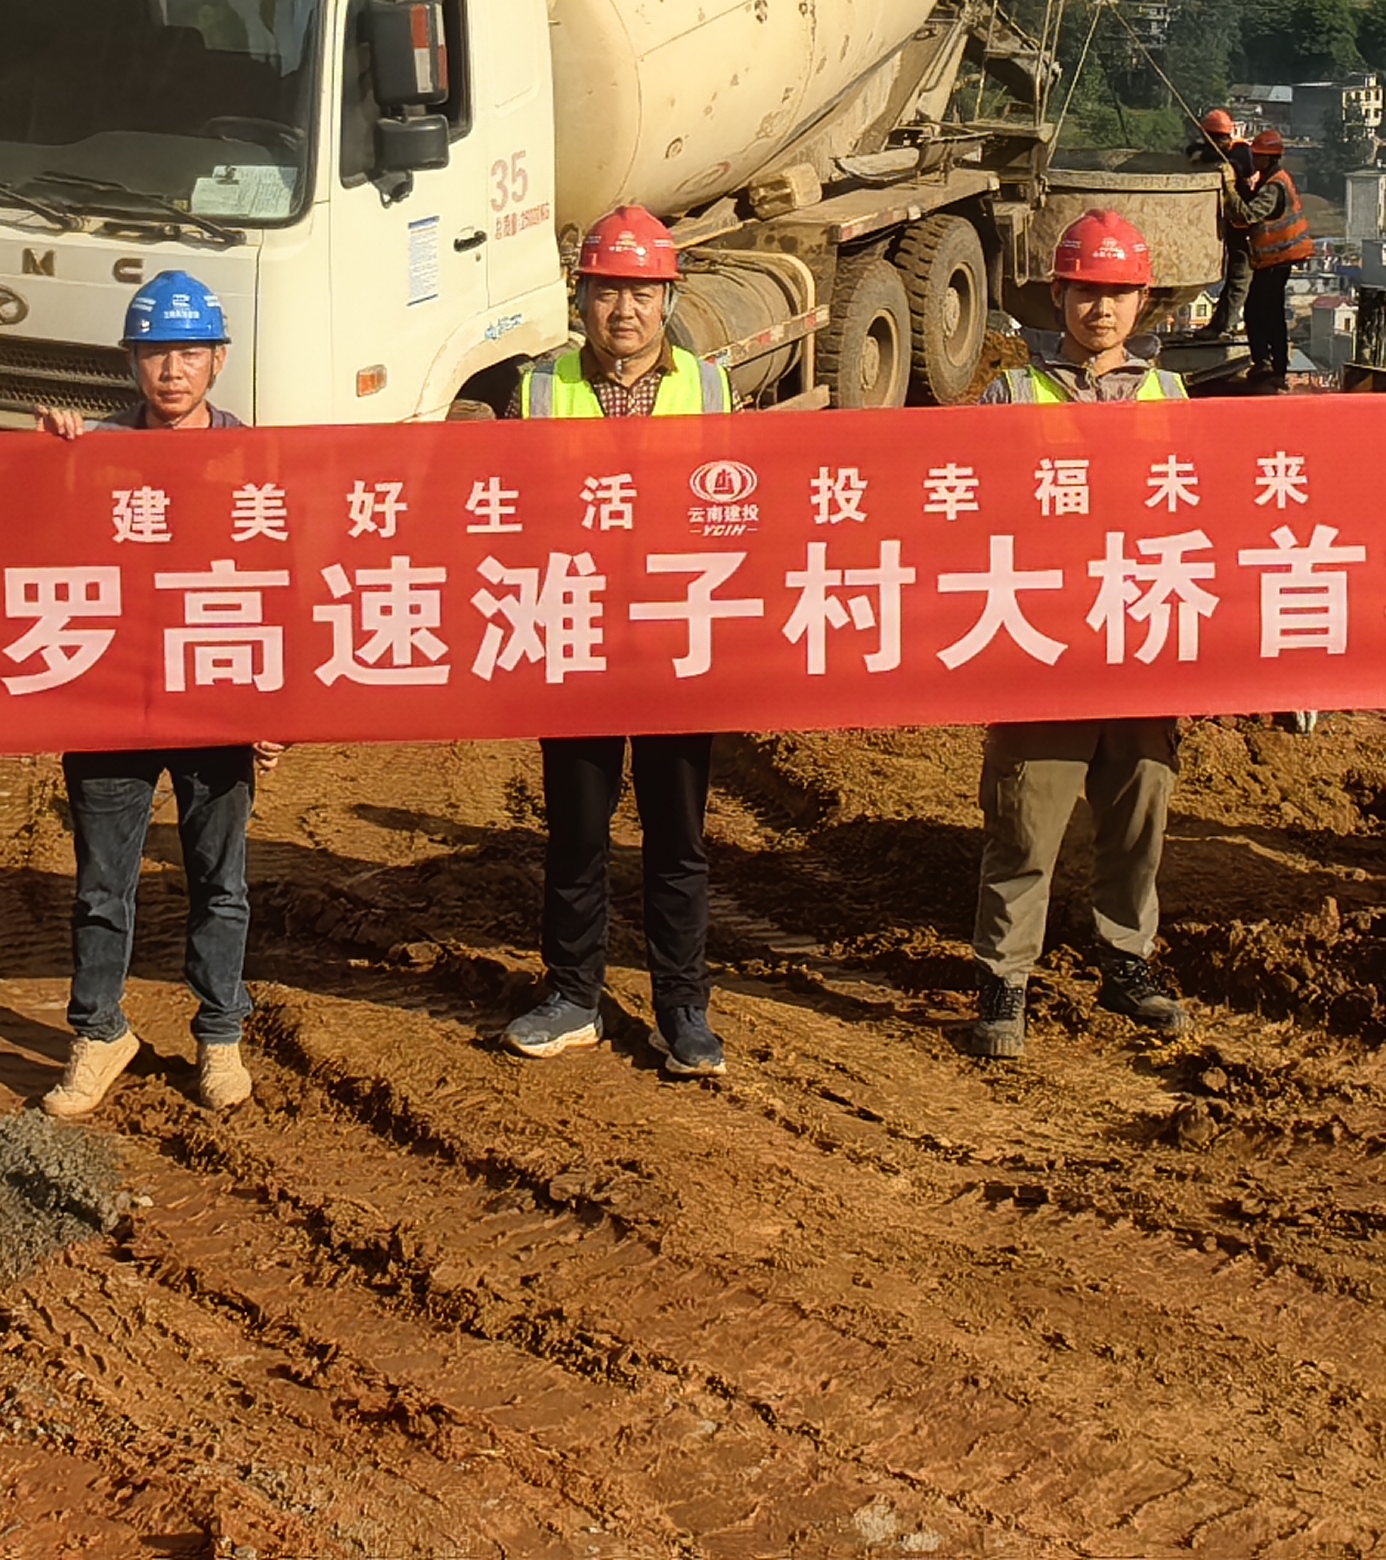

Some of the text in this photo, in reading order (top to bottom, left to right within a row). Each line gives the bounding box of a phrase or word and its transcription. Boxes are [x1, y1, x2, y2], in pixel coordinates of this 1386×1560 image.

[490, 149, 528, 212] 35
[111, 451, 1309, 544] 建美好生活 投幸福未来
[687, 504, 759, 523] 云南建投
